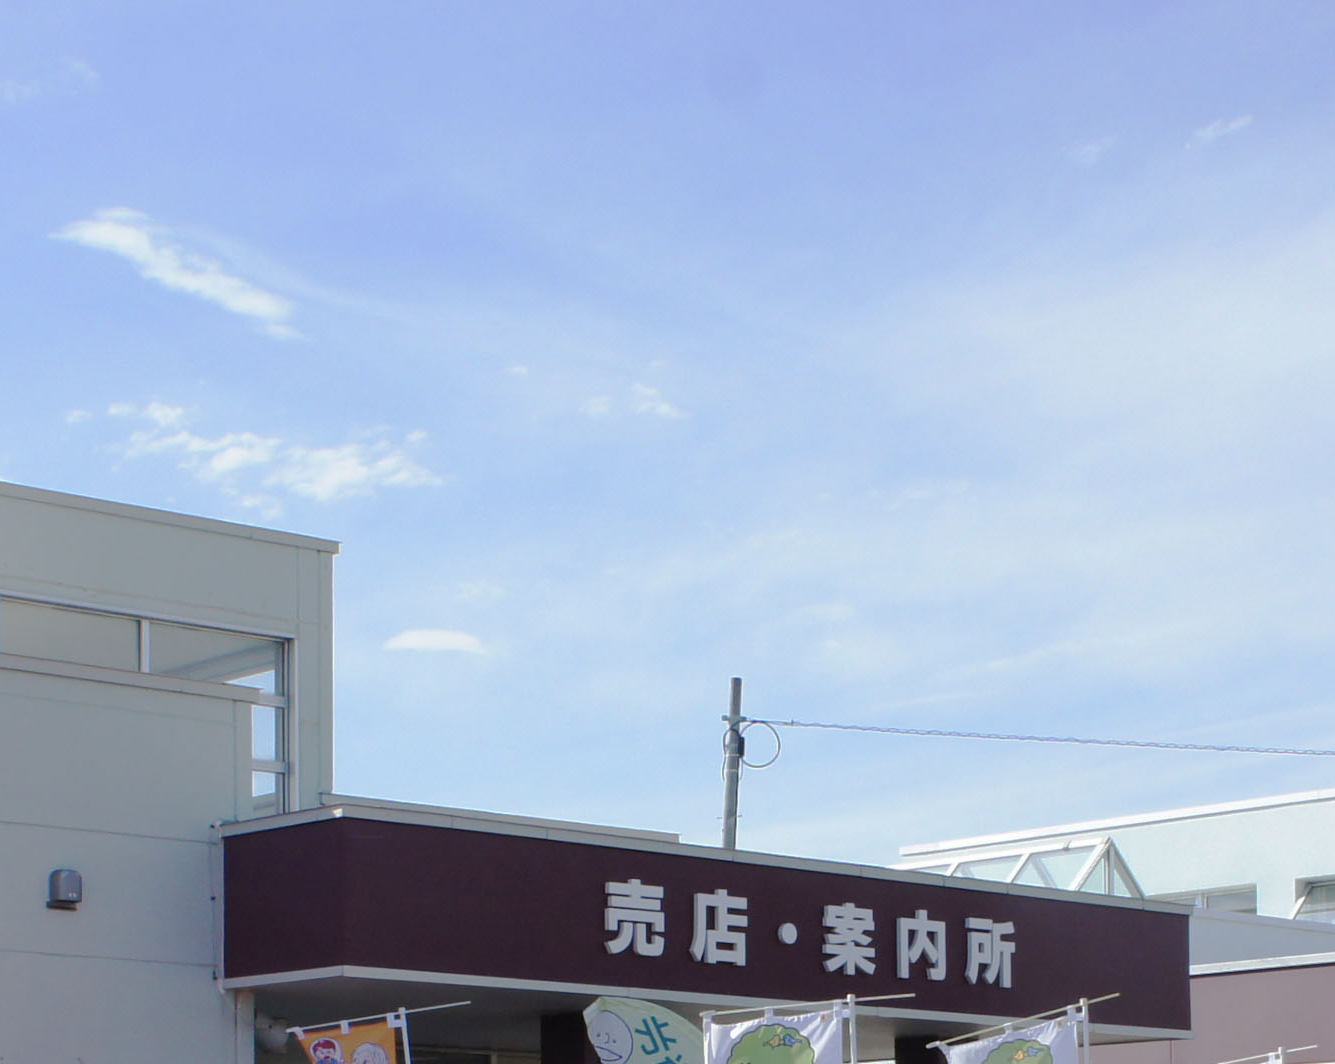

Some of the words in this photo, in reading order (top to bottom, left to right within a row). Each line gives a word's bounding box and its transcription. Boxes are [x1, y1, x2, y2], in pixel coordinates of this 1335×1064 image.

[604, 878, 1016, 988] 売店・案内所
